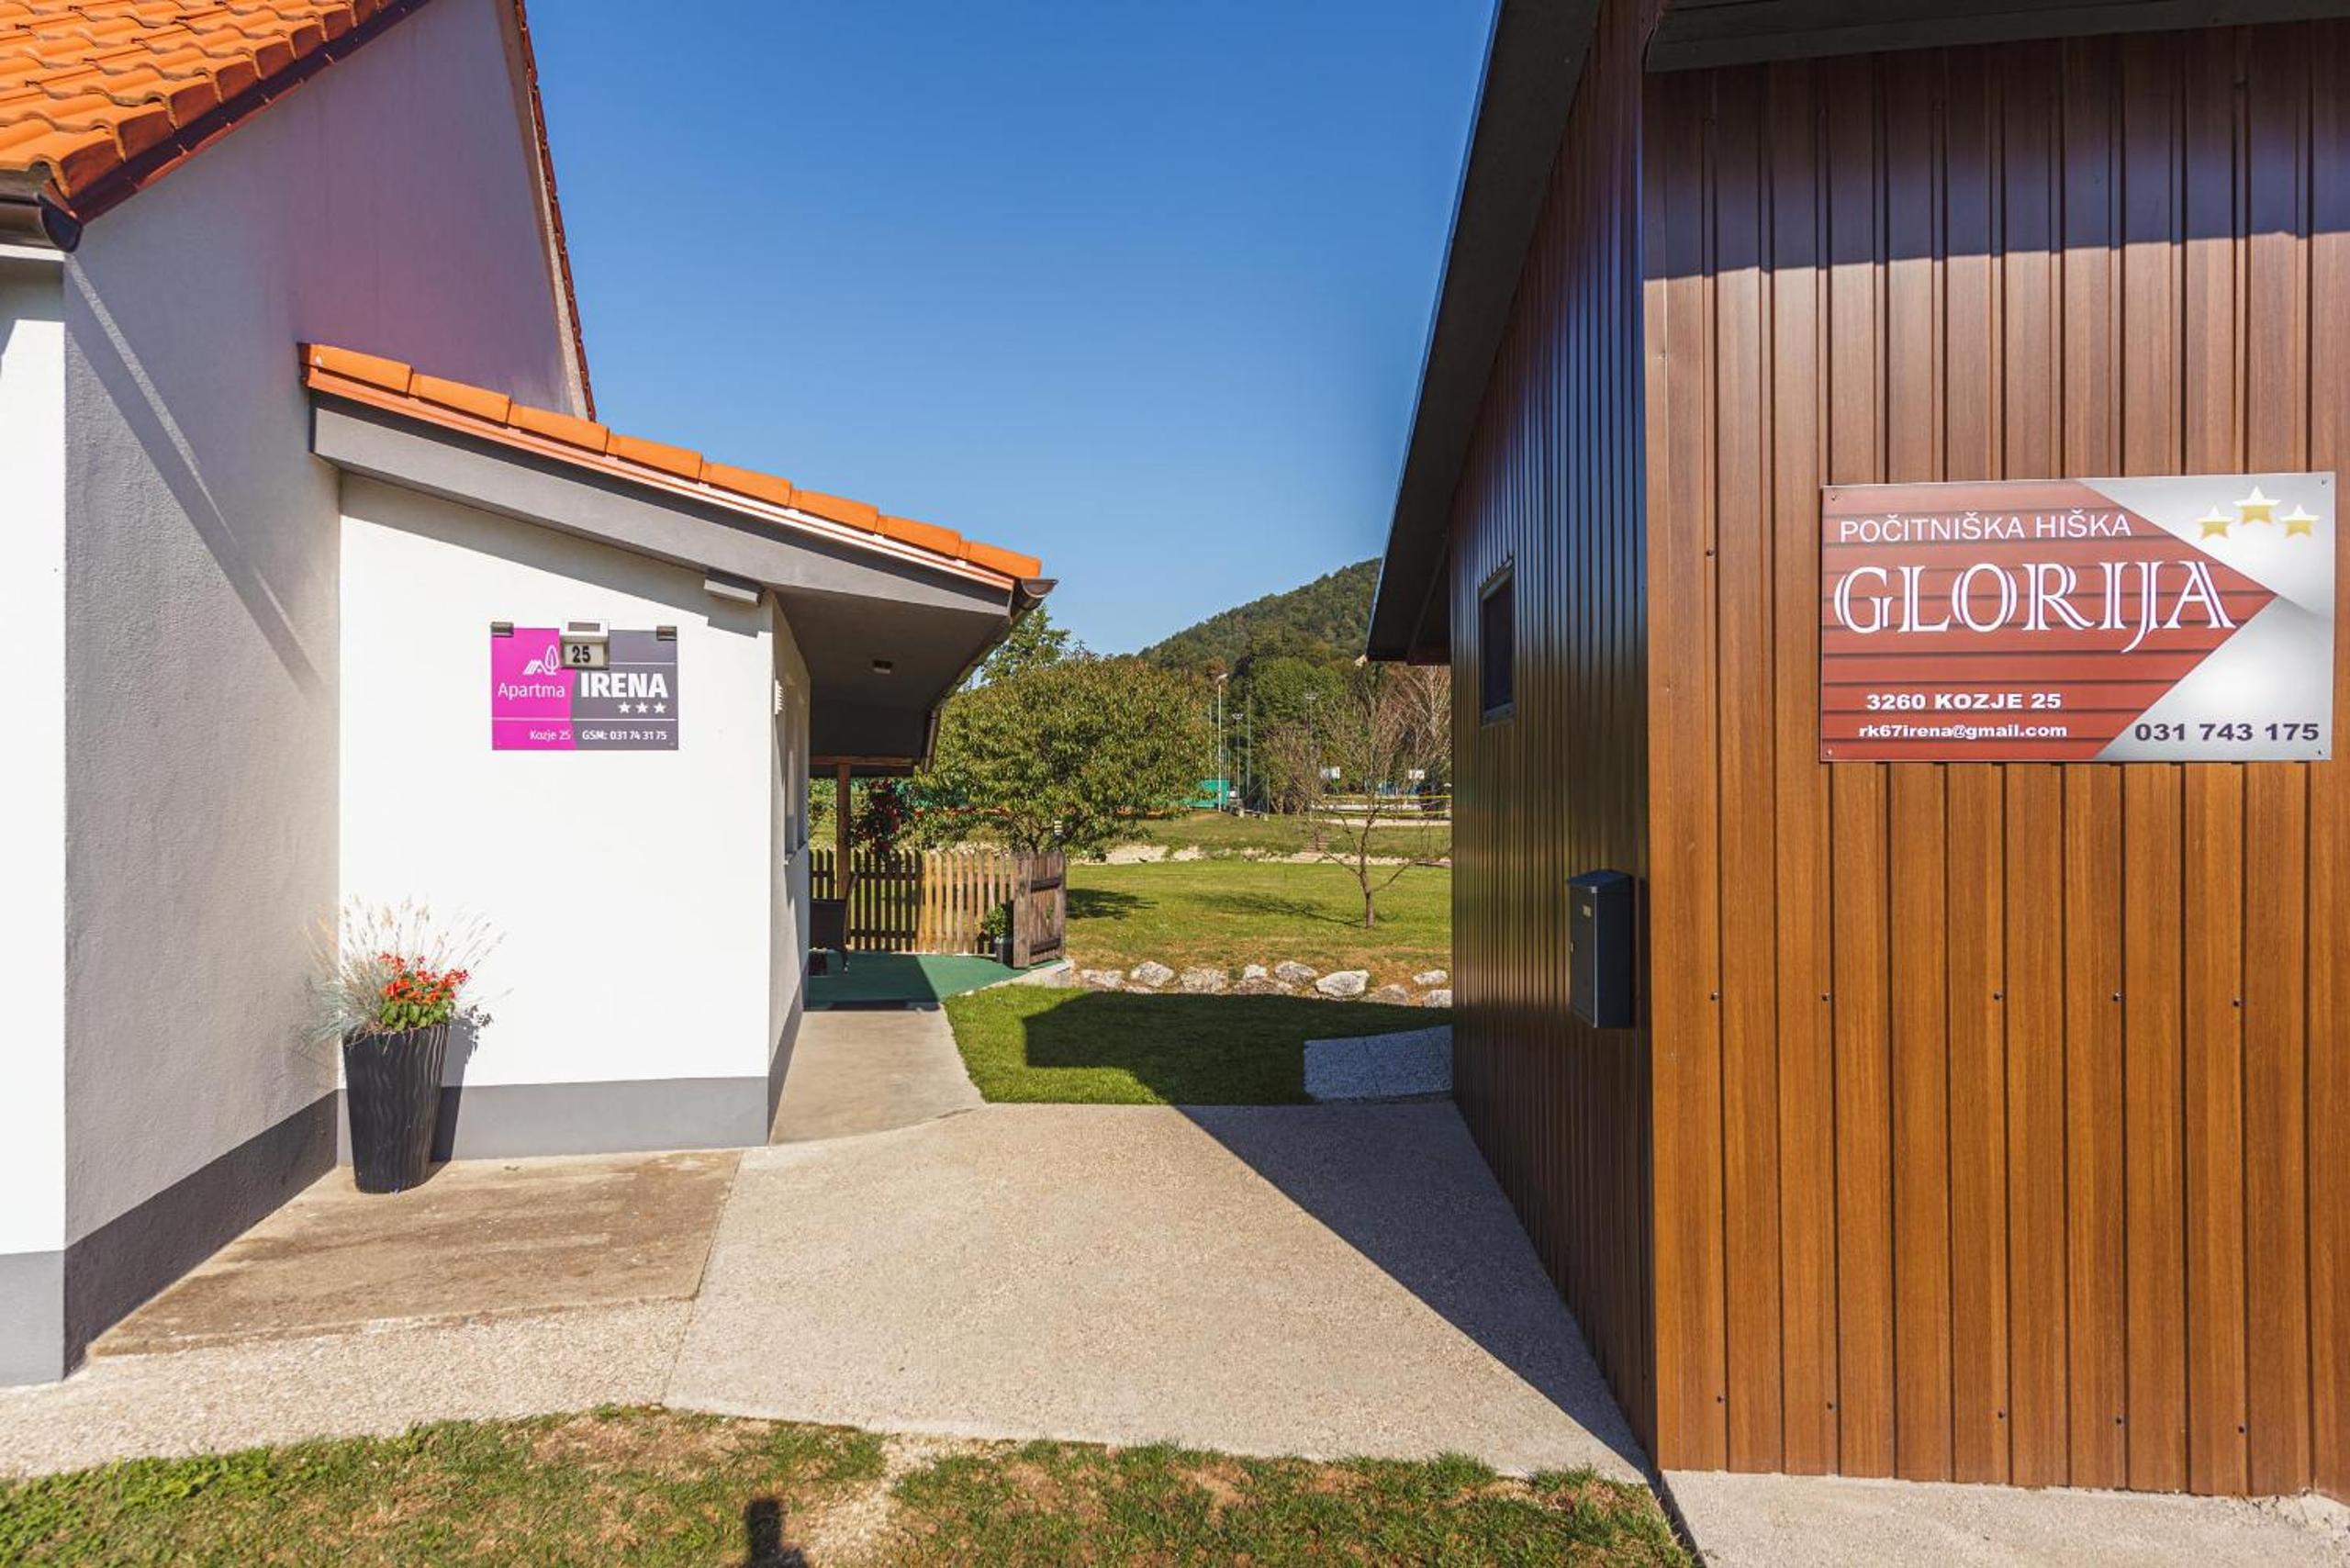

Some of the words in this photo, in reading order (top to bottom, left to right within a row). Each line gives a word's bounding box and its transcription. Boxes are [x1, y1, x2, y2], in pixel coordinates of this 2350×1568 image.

[1840, 512, 2026, 543] POČITNIŠKA
[2036, 508, 2132, 538] HIŠKA
[1834, 561, 2236, 654] GLORIJA
[572, 645, 591, 663] 25
[498, 683, 565, 700] Apartma
[581, 673, 668, 698] IRENA
[1867, 693, 1926, 711] 3260
[1934, 693, 2023, 711] KOZJE
[2031, 693, 2061, 709] 25
[530, 730, 556, 740] Kozje
[559, 731, 571, 740] 25
[583, 731, 608, 740] GSM:
[610, 731, 627, 740] 031
[1859, 723, 2068, 742] rk67irena@gmail.com
[2135, 723, 2186, 742] 031
[2199, 723, 2253, 742] 743
[2266, 722, 2319, 741] 175
